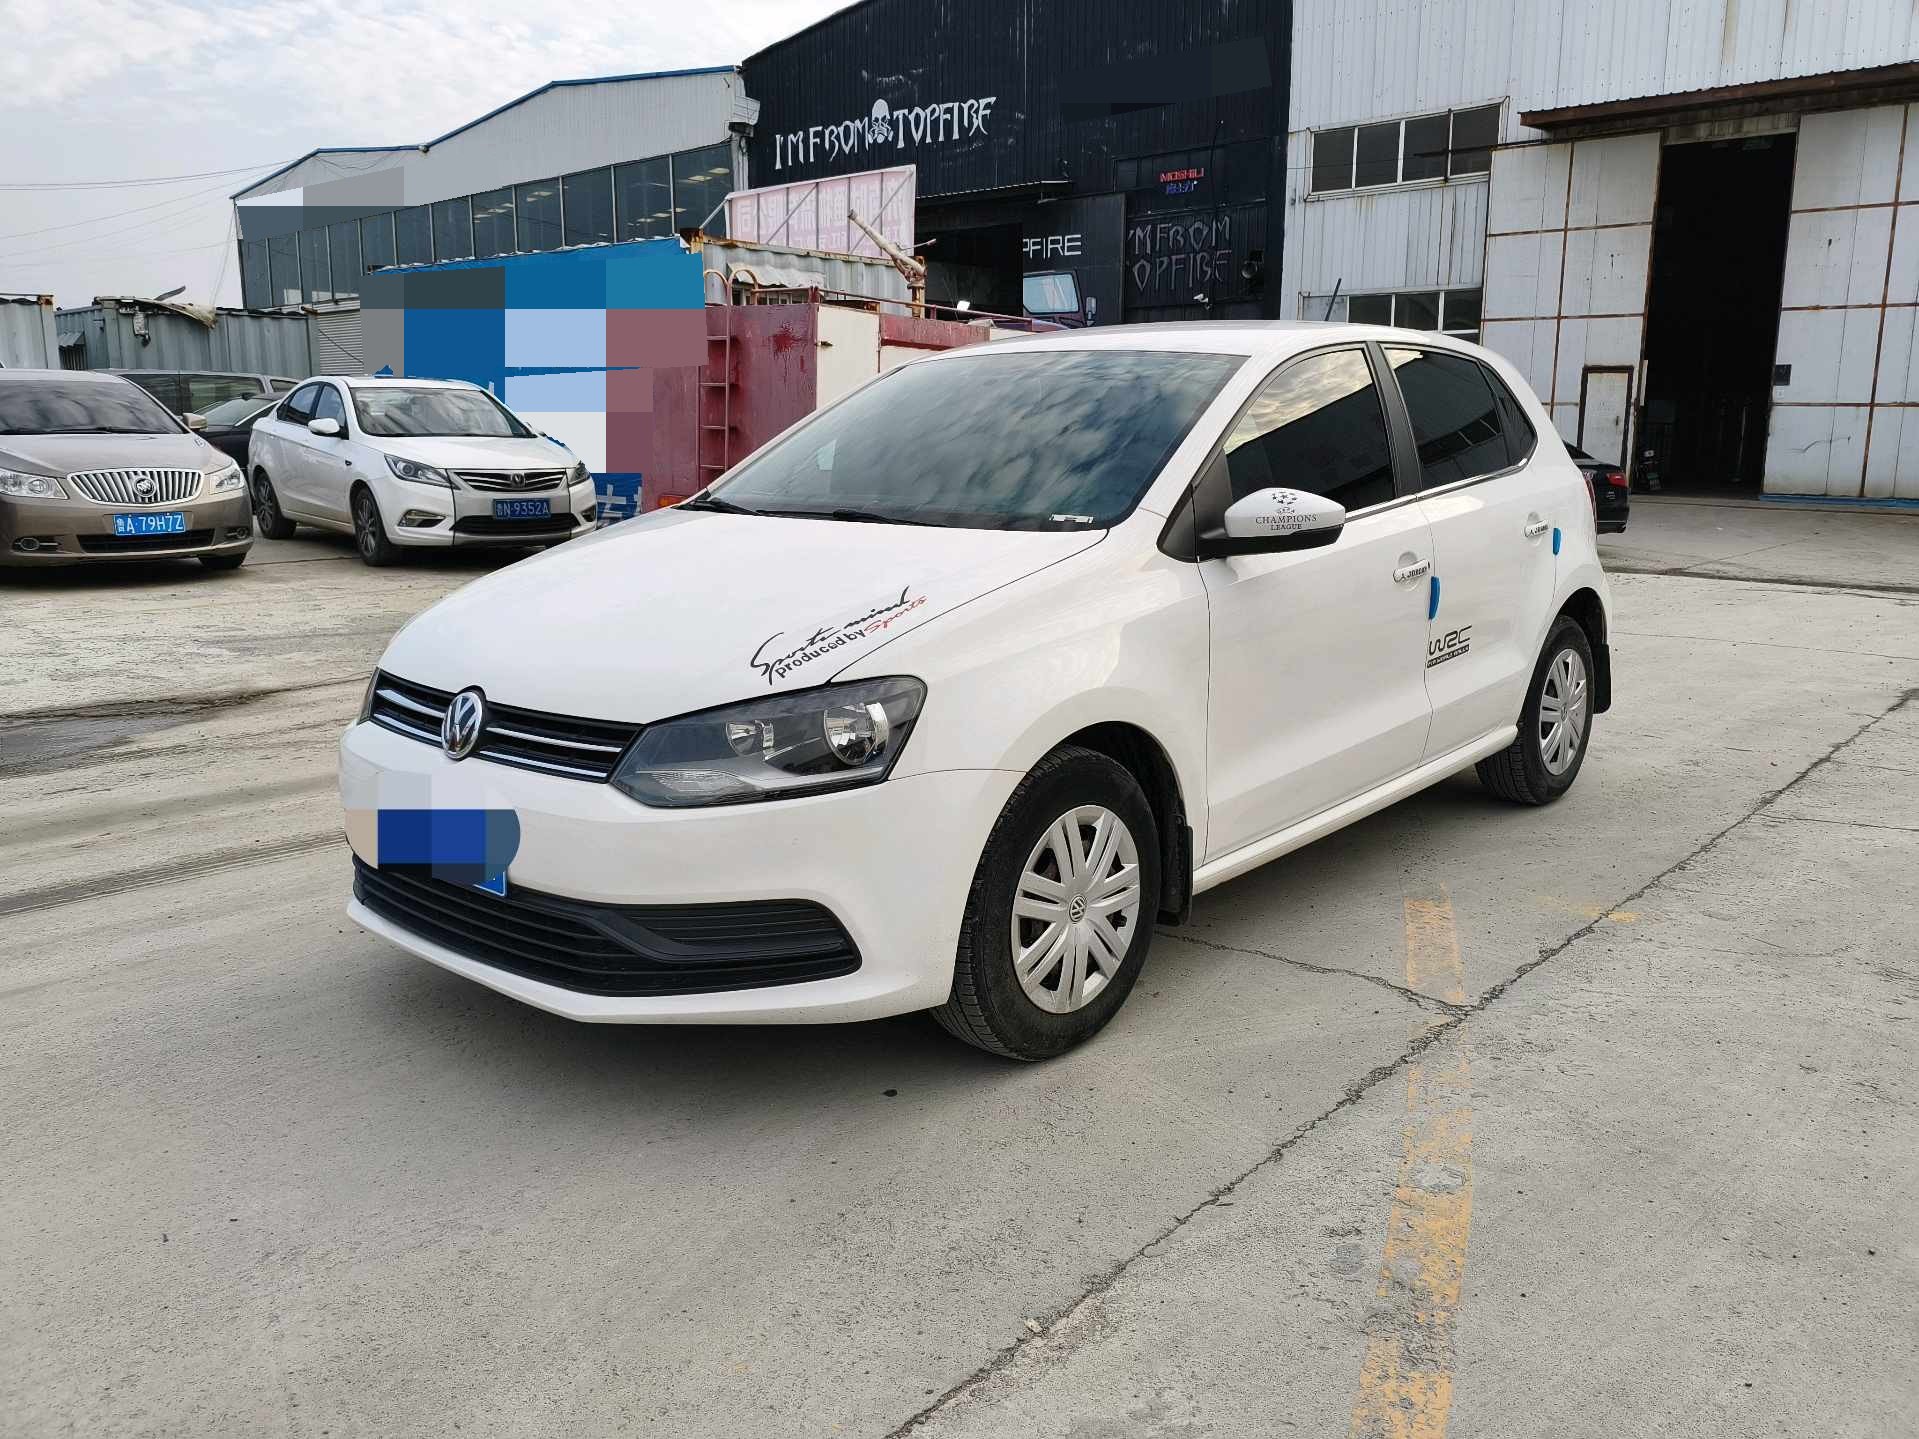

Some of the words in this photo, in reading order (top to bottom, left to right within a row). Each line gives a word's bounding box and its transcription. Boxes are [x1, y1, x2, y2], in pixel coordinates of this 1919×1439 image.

[809, 116, 869, 162] FROM
[893, 96, 997, 149] TOPFIRE
[1255, 514, 1317, 525] CHAMPIONS
[1270, 523, 1303, 531] LEAGUE
[774, 636, 848, 679] produced
[843, 629, 867, 642] by
[863, 595, 928, 634] Sports
